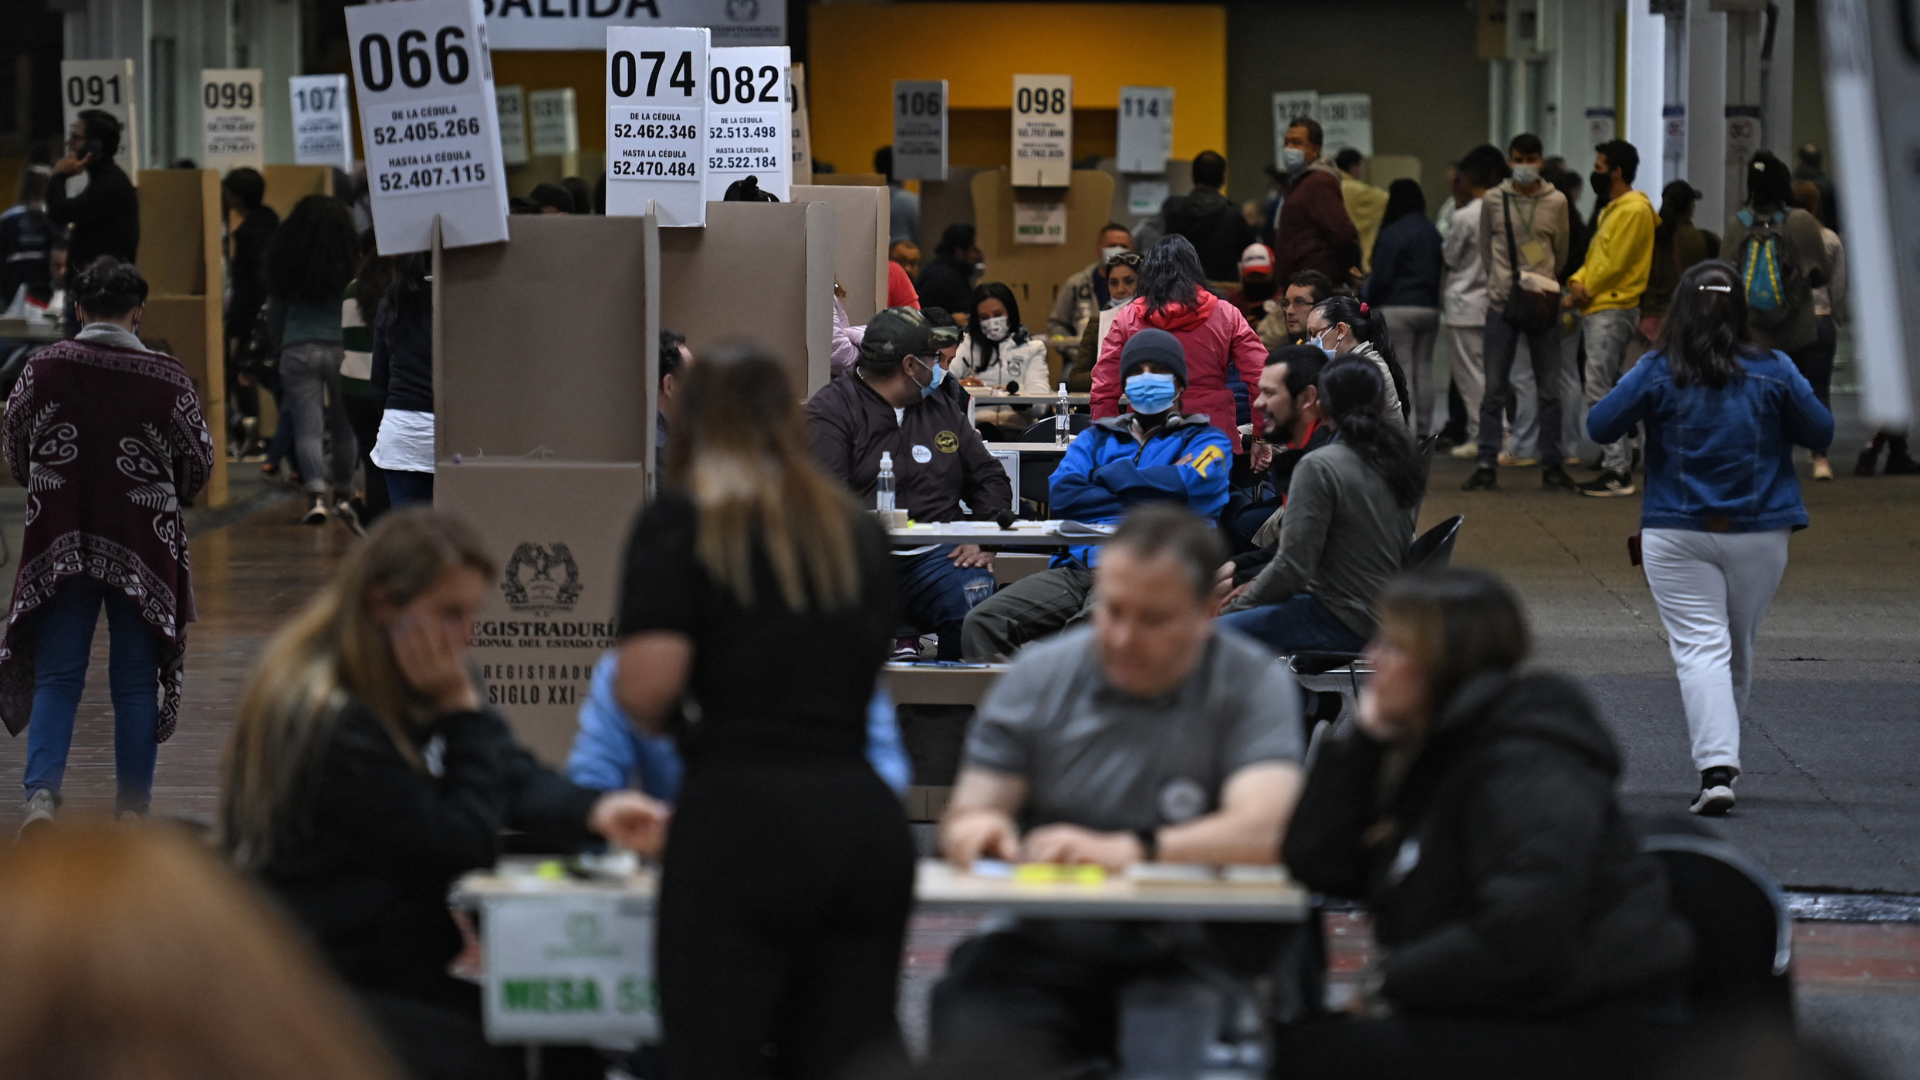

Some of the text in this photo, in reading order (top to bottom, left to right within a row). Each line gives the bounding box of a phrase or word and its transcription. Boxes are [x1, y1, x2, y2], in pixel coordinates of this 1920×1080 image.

[484, 0, 660, 18] ALIDA
[359, 25, 469, 92] 066
[611, 50, 696, 98] 074
[67, 75, 120, 106] 091
[710, 65, 779, 105] 082
[204, 82, 253, 109] 099
[295, 86, 338, 112] 107
[897, 91, 941, 116] 106
[1017, 87, 1066, 115] 098
[391, 104, 458, 120] DE LA CÉDULA
[630, 110, 681, 121] DE LA CÉDULA
[1123, 97, 1159, 118] 114
[738, 115, 763, 124] CÉDULA
[374, 117, 480, 145] 52.405.266
[614, 124, 697, 140] 52.462.346
[709, 126, 776, 139] 52.513.498
[388, 150, 472, 168] HASTA LA CÉDULA
[622, 148, 687, 159] HASTA LA CÉDULA
[745, 146, 769, 154] CÉDULA
[613, 160, 696, 177] 52.470.484
[709, 156, 777, 169] 52.522.184
[379, 163, 485, 191] 52.407.115
[471, 617, 619, 637] EGISTRADURÍ
[465, 638, 514, 648] CIONAL
[518, 639, 542, 648] DEL
[546, 639, 593, 649] ESTADO
[484, 664, 592, 680] REGISTRADU
[489, 685, 575, 705] SIGLO XXI
[502, 976, 601, 1013] MESA
